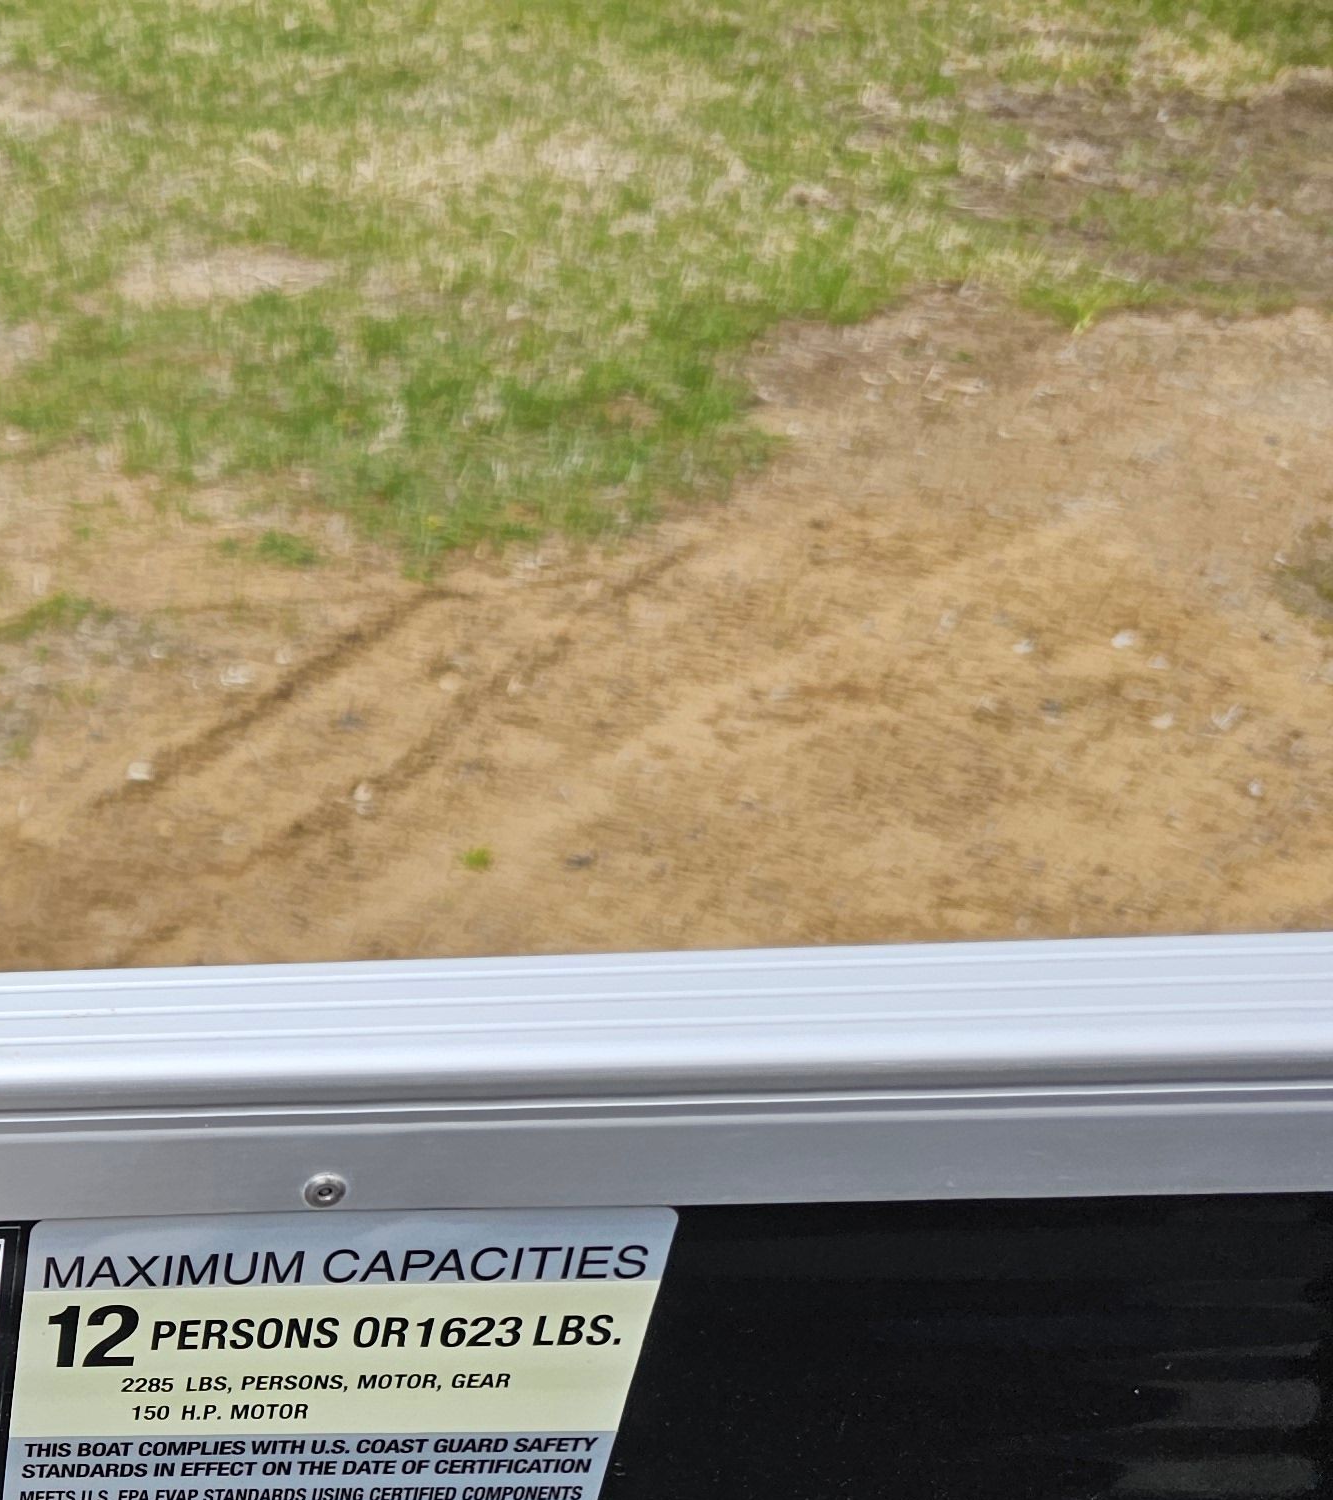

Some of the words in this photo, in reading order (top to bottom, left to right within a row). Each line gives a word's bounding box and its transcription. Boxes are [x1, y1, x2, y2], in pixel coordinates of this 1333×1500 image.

[42, 1251, 306, 1288] MAXIMUM
[322, 1245, 649, 1283] CAPACITIES
[48, 1304, 139, 1367] 12
[150, 1317, 340, 1350] PERSONS
[353, 1316, 408, 1348] OR
[417, 1316, 523, 1348] 1623
[532, 1314, 622, 1346] LBS.
[120, 1377, 175, 1393] 2285
[185, 1375, 233, 1394] LBS,
[240, 1374, 349, 1392] PERSONS,
[356, 1373, 442, 1391] MOTOR,
[451, 1373, 511, 1389] GEAR
[131, 1405, 170, 1421] 150
[180, 1404, 222, 1421] H.P.
[229, 1403, 309, 1420] MOTOR
[24, 1442, 72, 1458] THIS
[76, 1441, 135, 1458] BOAT
[138, 1440, 247, 1457] COMPLIES
[250, 1439, 306, 1455] WITH
[310, 1439, 351, 1455] U.S.
[355, 1438, 430, 1454] COAST
[432, 1438, 509, 1454] GUARD
[512, 1437, 599, 1453] SAFETY
[21, 1463, 149, 1479] STANDARDS
[152, 1462, 176, 1478] IN
[179, 1461, 259, 1477] EFFECT
[261, 1461, 293, 1476] ON
[296, 1460, 339, 1476] THE
[341, 1460, 398, 1476] DATE
[400, 1459, 431, 1475] OF
[433, 1458, 593, 1475] CERTIFICATION
